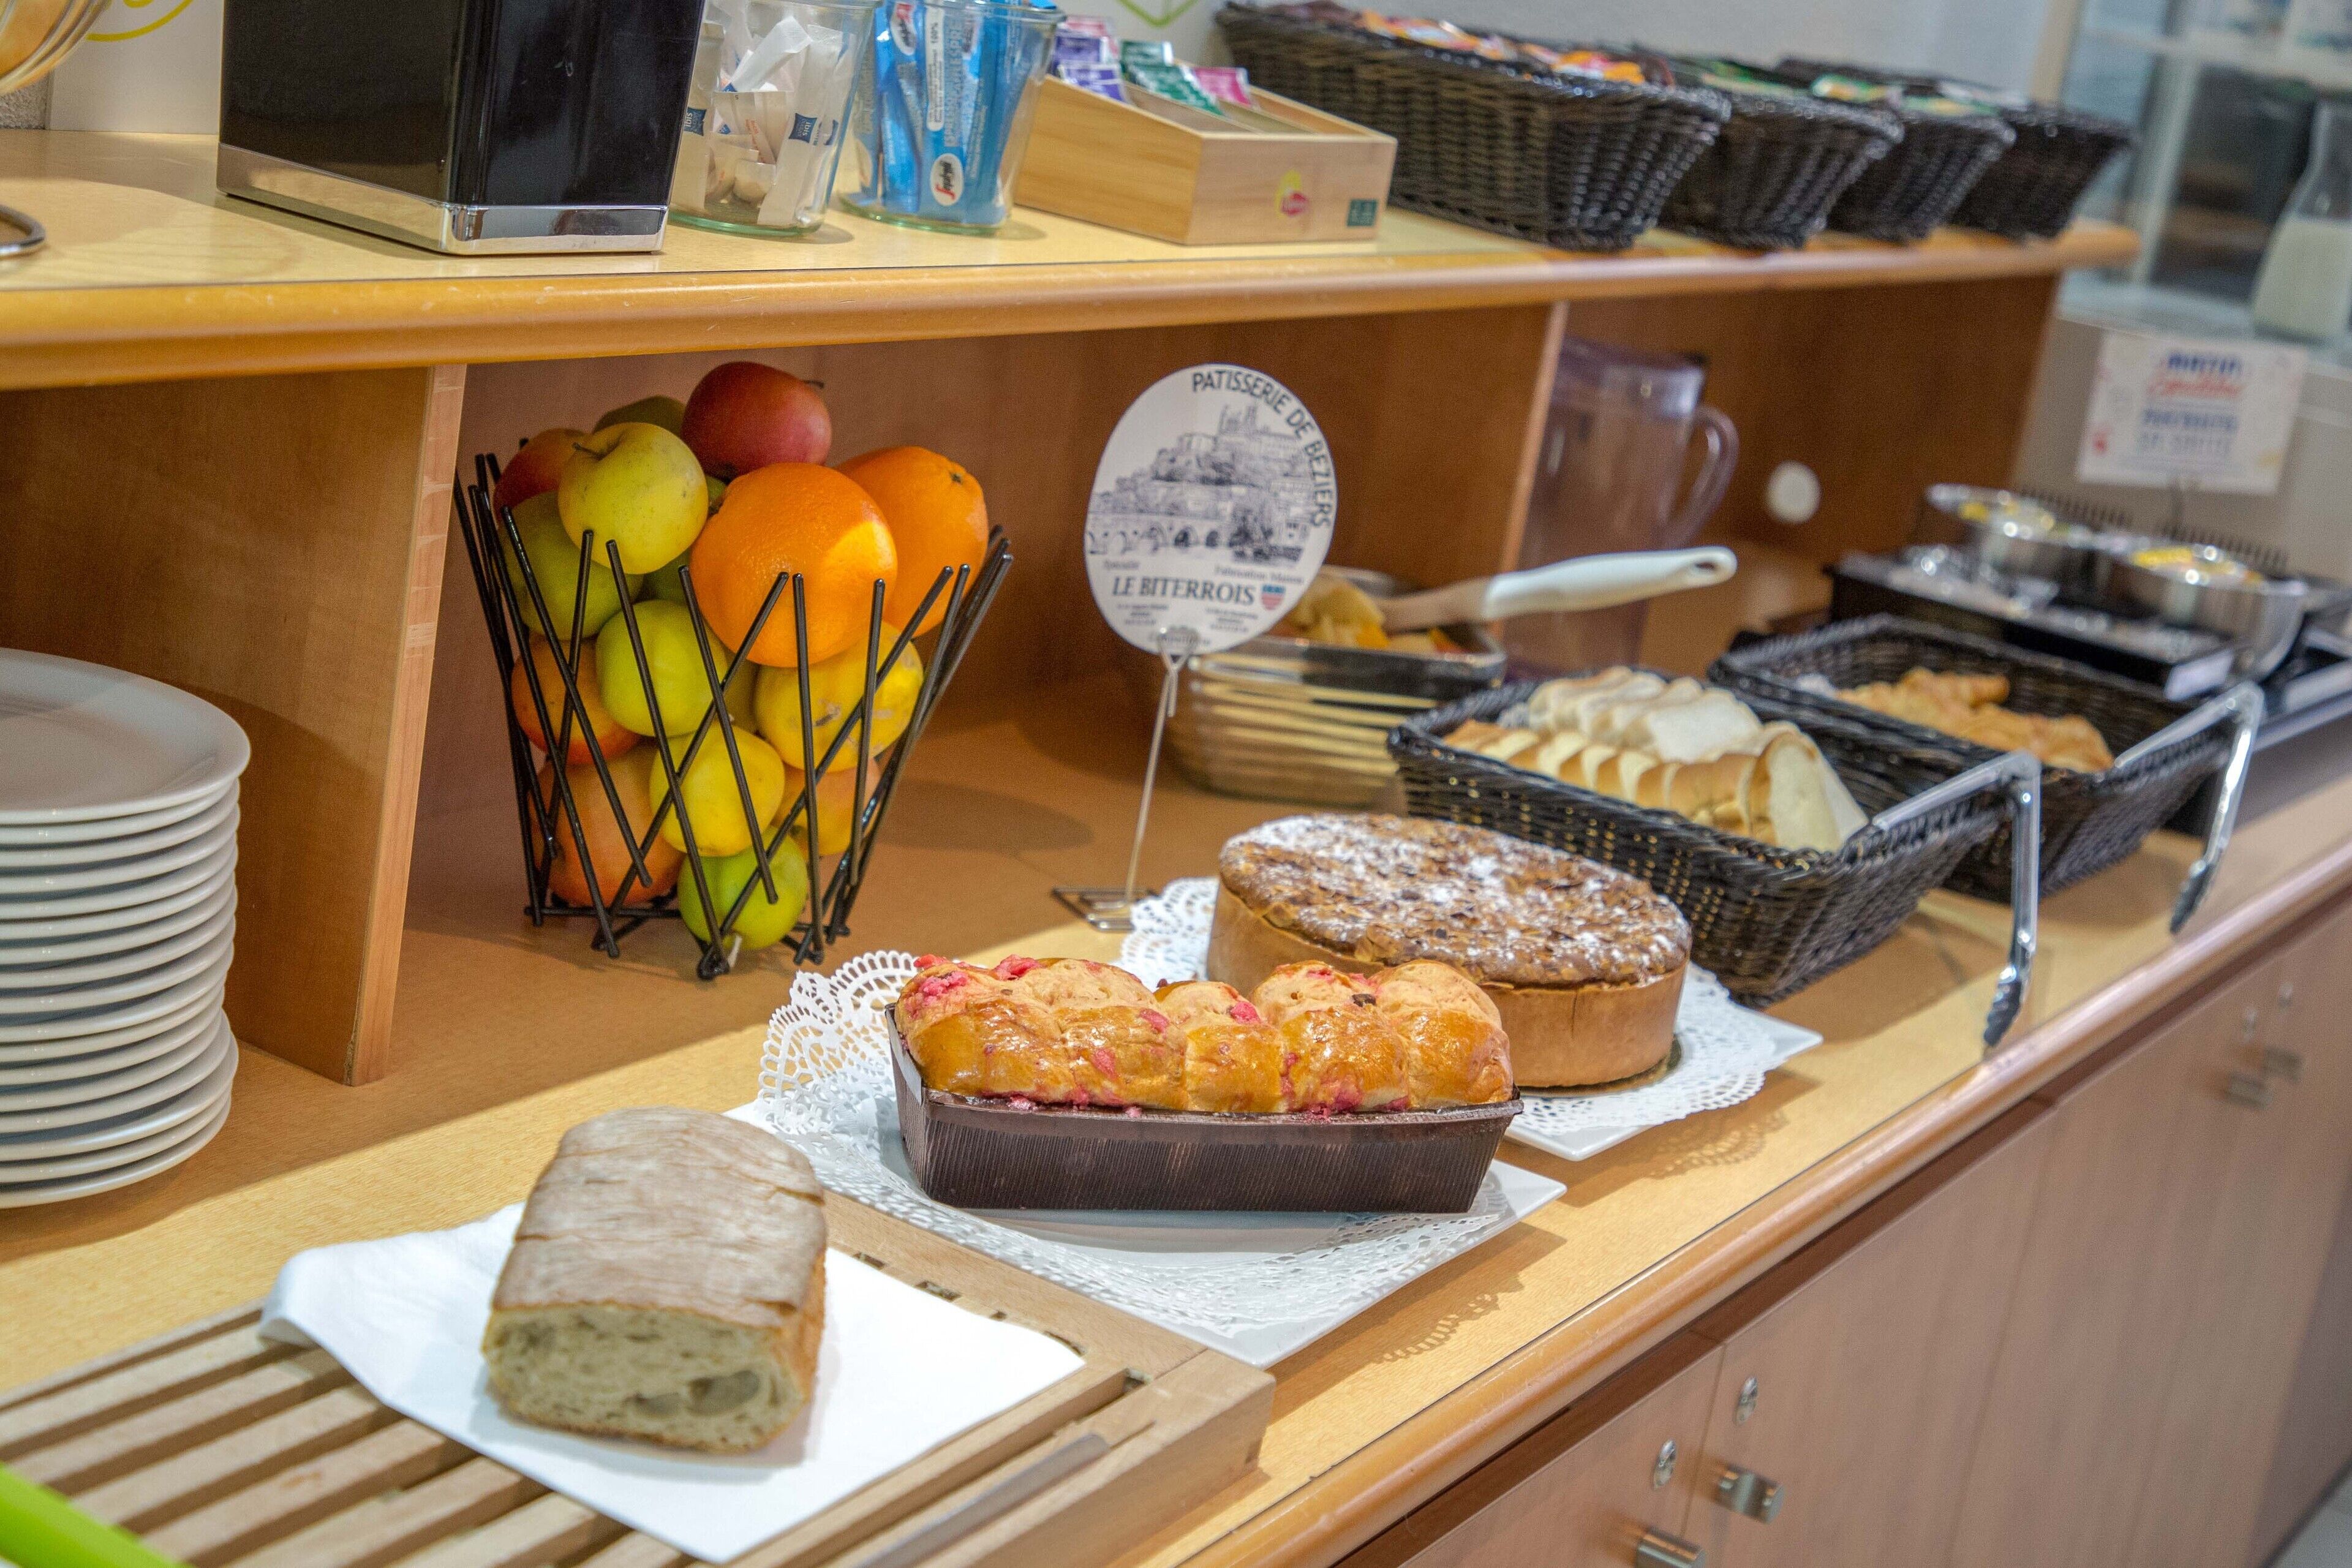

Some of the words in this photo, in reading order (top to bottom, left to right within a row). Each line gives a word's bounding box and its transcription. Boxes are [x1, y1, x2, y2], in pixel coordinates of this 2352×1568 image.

[684, 112, 693, 127] ibis
[802, 121, 812, 136] ibis
[1191, 370, 1291, 414] PATISSERIE
[1286, 409, 1314, 440] DE
[1304, 440, 1332, 527] BEZIERS
[1112, 576, 1136, 597] LE
[1138, 578, 1256, 606] BITERROIS
